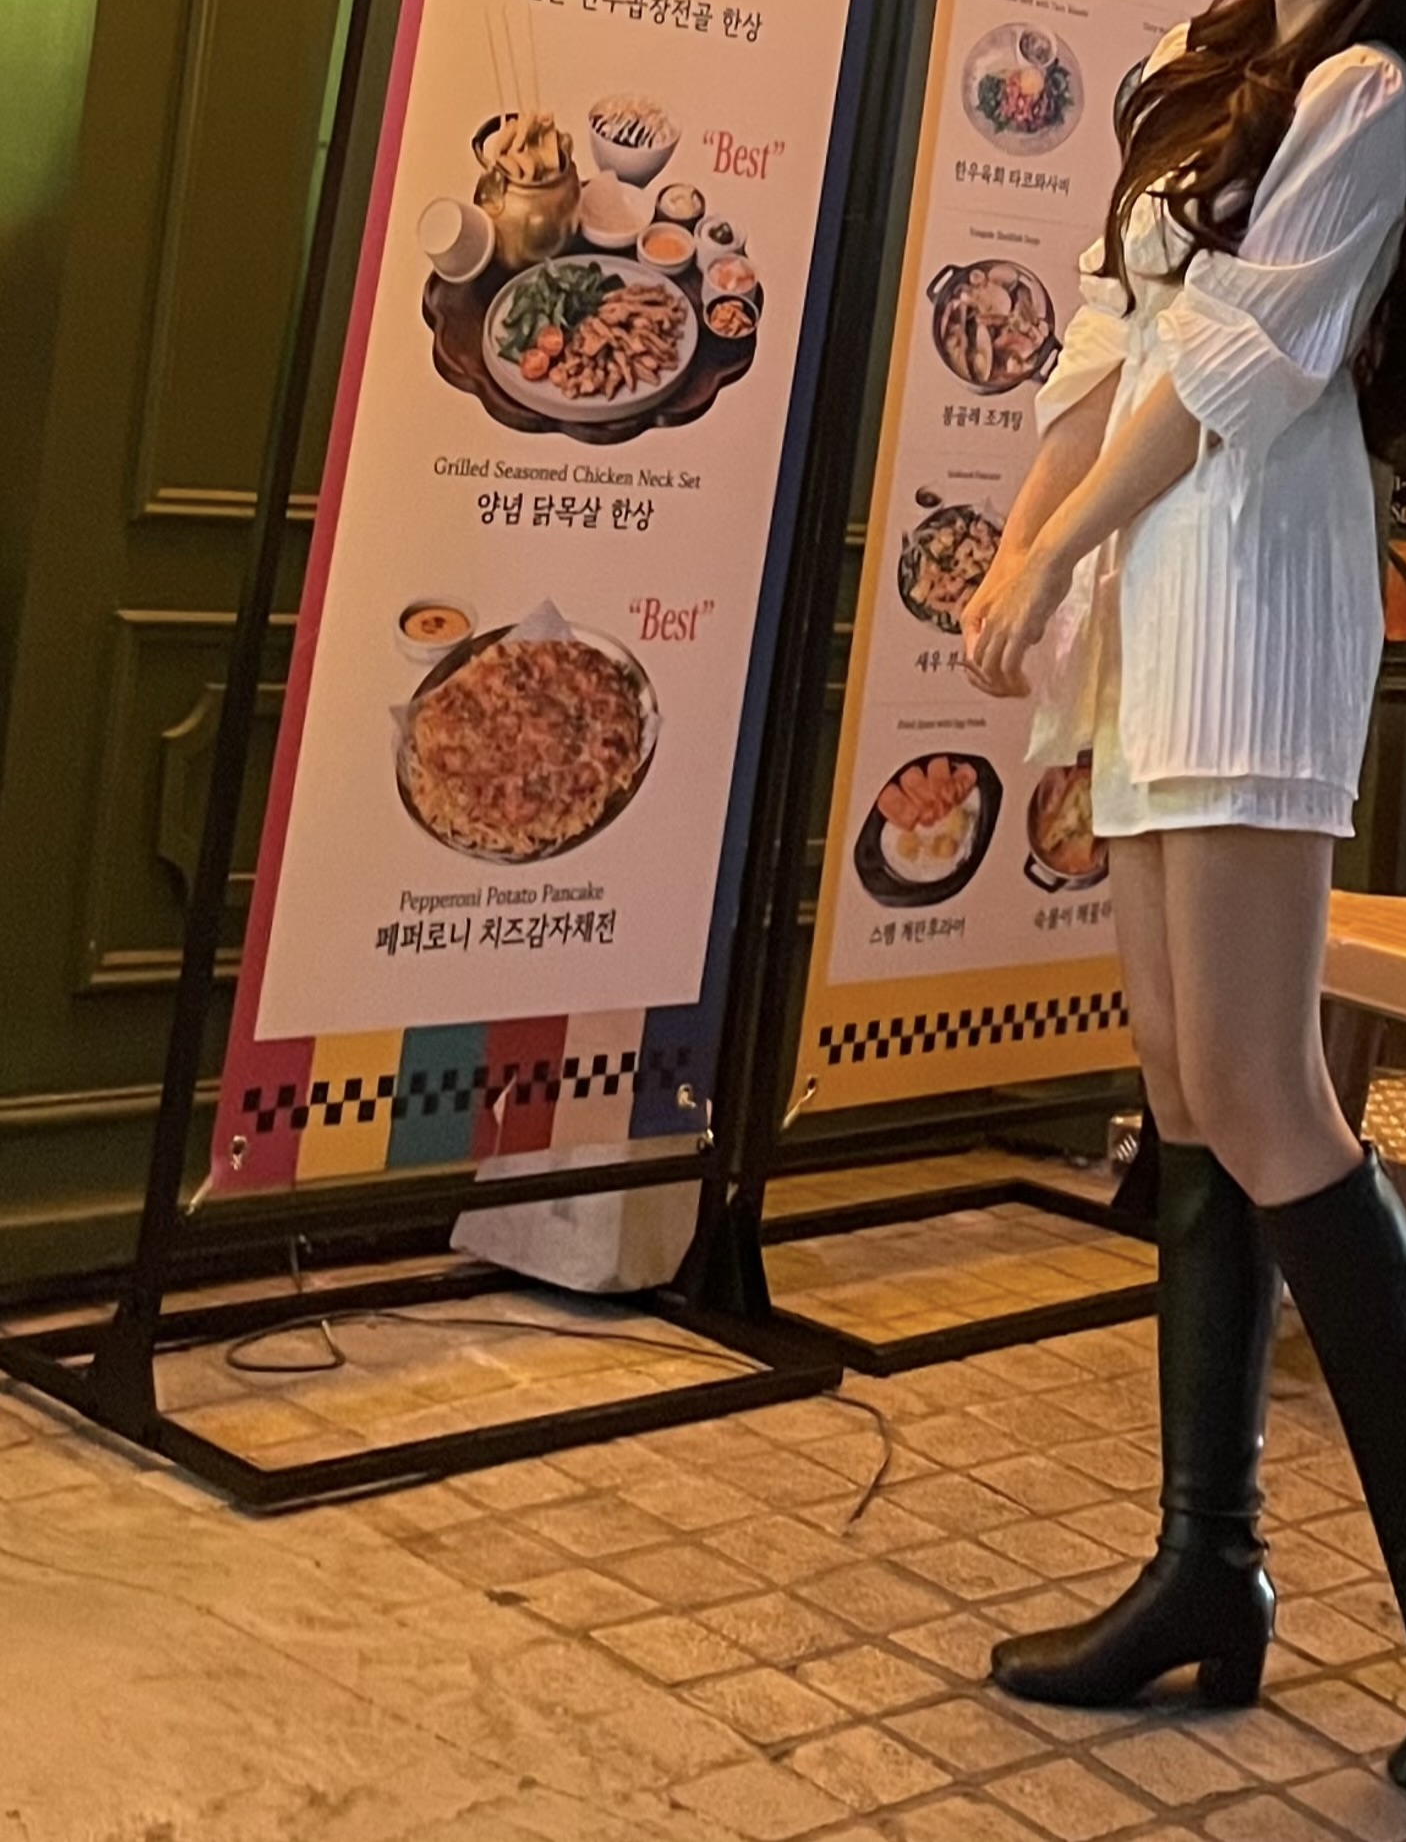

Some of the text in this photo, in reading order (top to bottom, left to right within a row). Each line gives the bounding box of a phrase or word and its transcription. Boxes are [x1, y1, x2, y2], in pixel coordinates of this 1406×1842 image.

[722, 7, 763, 43] 한상
[955, 159, 1006, 187] 한우육회
[434, 457, 701, 489] Grilled Seasoned Chicken Neck Set
[477, 490, 655, 531] 양념 닭목살 한상
[400, 881, 605, 915] Pepperoni Potato Pancake
[375, 909, 617, 956] 페퍼로니 치즈감자채전
